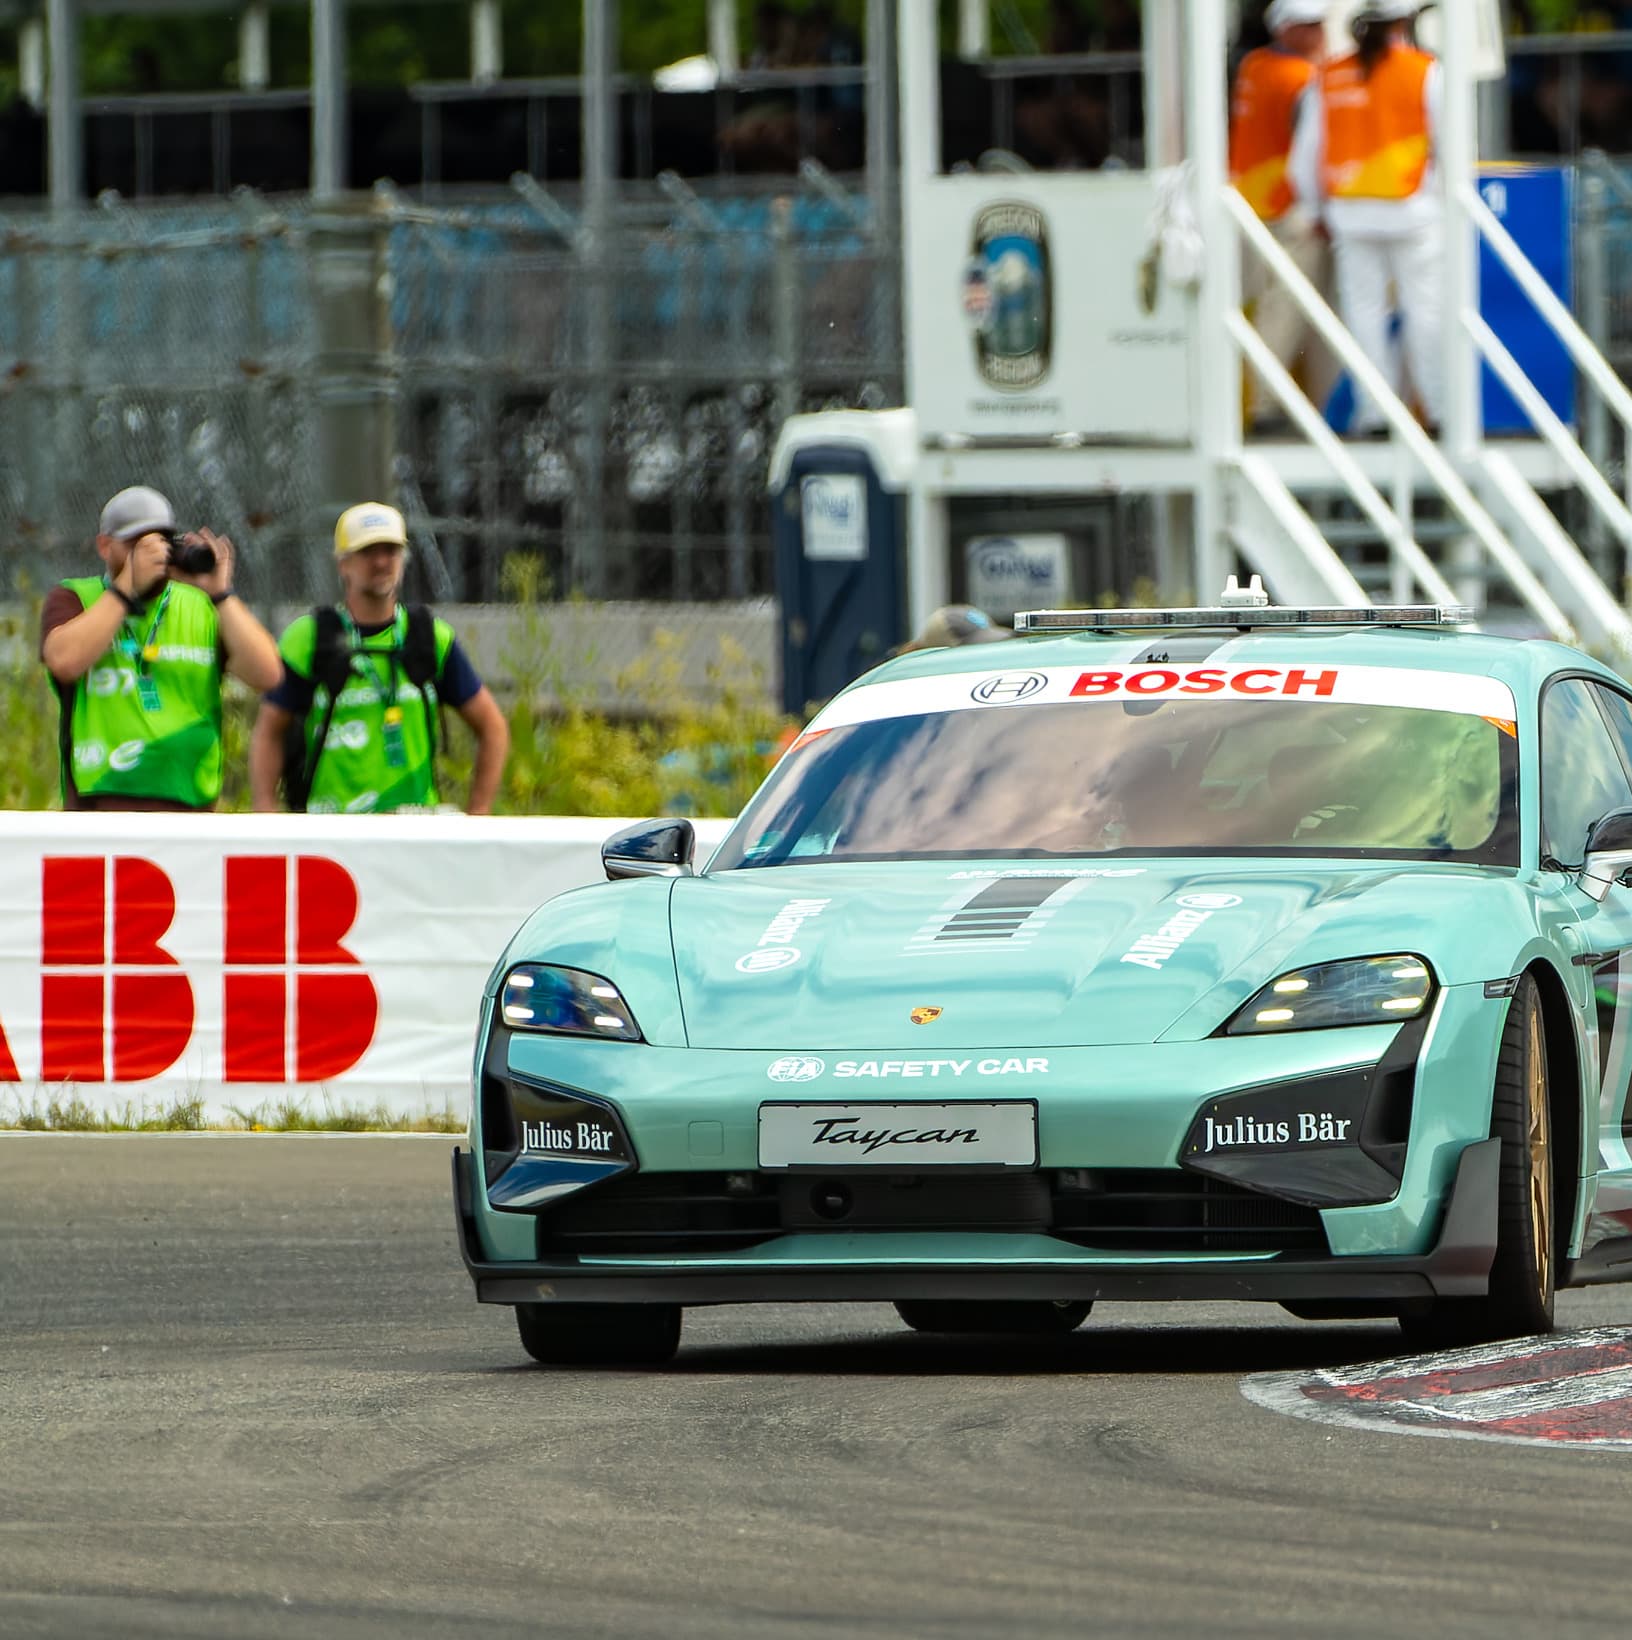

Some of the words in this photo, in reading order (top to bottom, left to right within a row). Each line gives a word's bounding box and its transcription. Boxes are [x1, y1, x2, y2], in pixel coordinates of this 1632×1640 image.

[1068, 668, 1339, 697] BOSCH
[1120, 909, 1215, 970] Allianz
[833, 1060, 972, 1078] SAFETY
[976, 1057, 1050, 1075] CAR
[520, 1120, 573, 1155] Julius
[576, 1122, 614, 1151] Bär
[812, 1117, 980, 1155] Taycan
[1204, 1116, 1290, 1153] Julius
[1297, 1112, 1352, 1142] Bär
